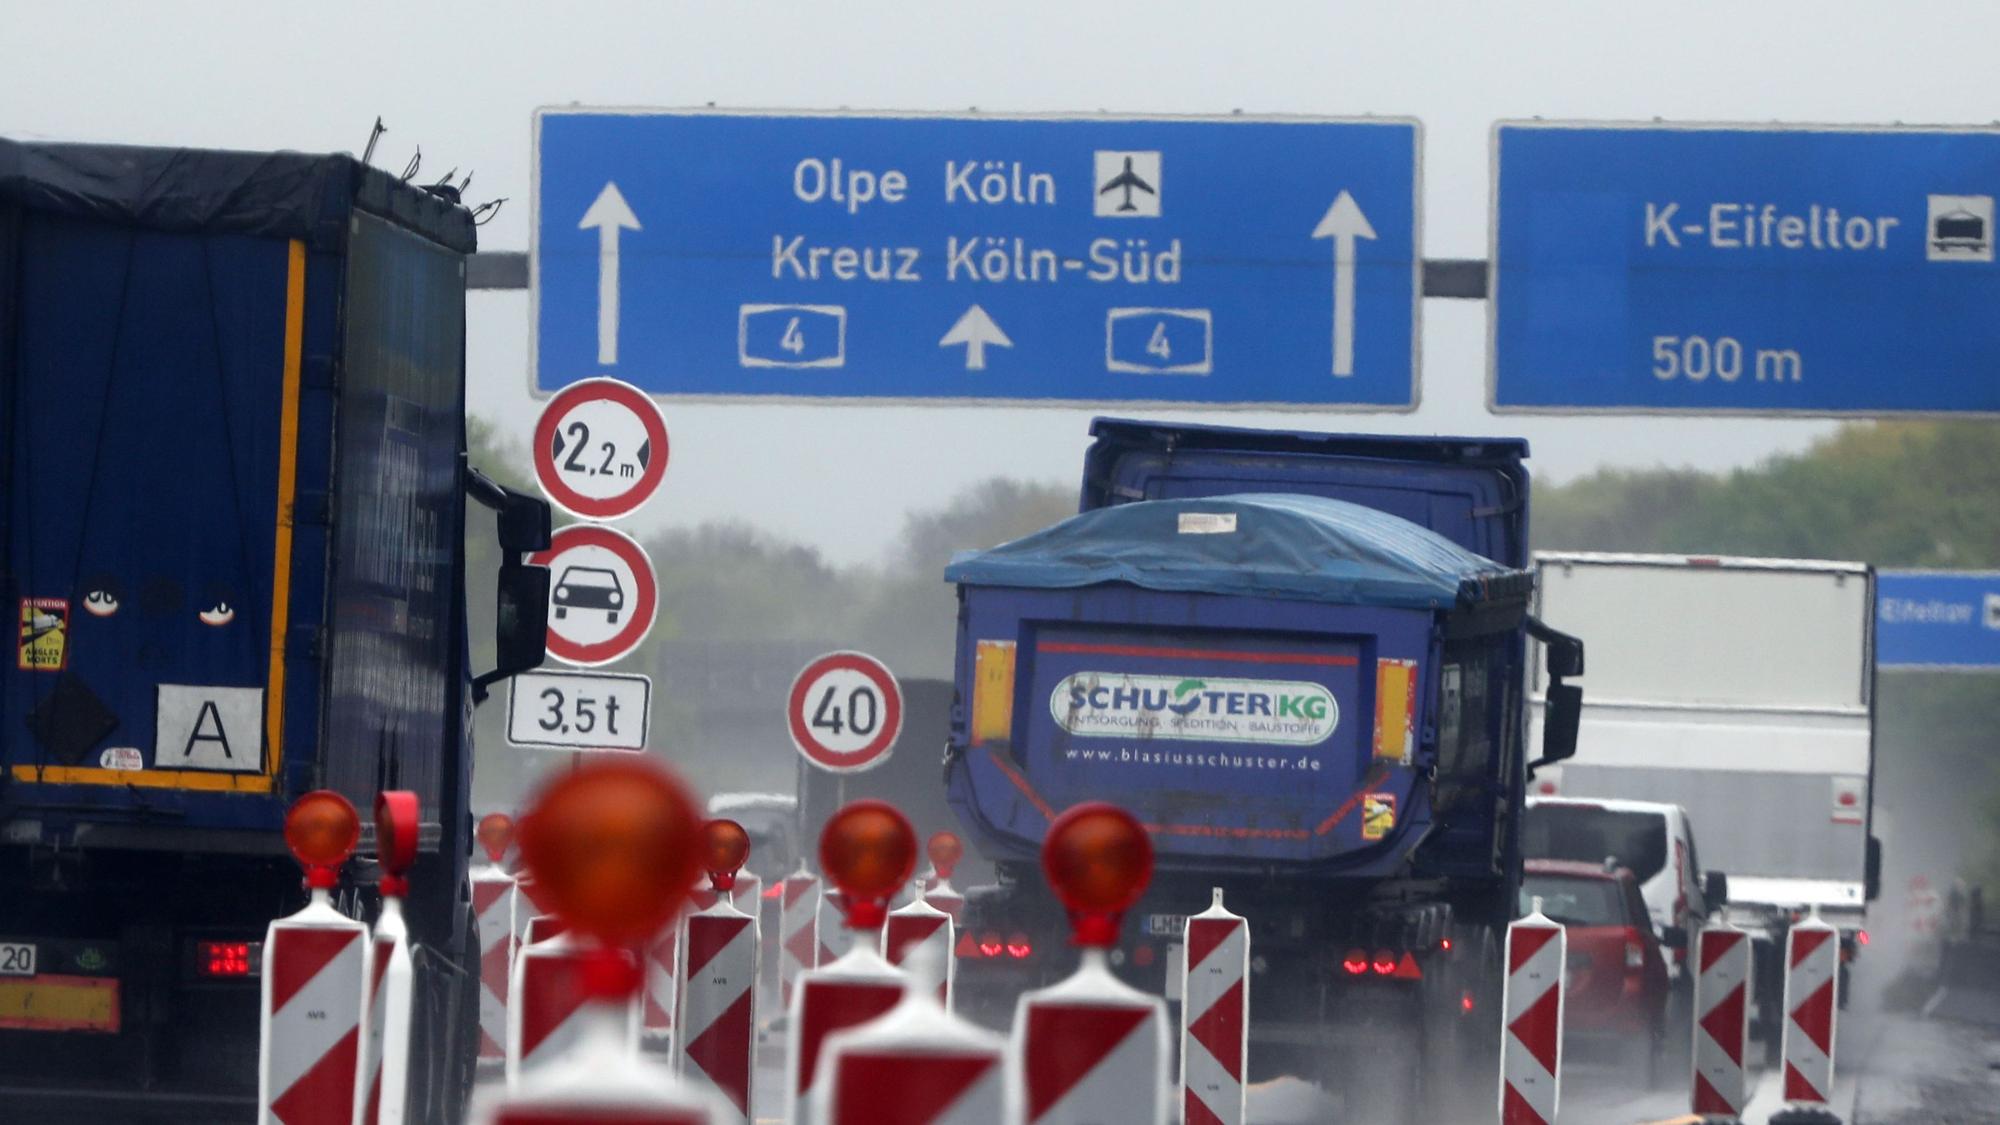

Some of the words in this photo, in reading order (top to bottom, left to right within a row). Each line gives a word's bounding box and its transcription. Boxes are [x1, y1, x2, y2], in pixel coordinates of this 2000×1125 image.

[793, 158, 908, 214] Olpe
[945, 160, 1056, 204] Köln
[1644, 202, 1900, 250] K-Eifeltor
[772, 234, 921, 281] Kreuz
[947, 236, 1182, 284] Köln-Süd
[781, 317, 804, 355] 4
[1147, 321, 1171, 359] 4
[1652, 335, 1743, 382] 500
[1755, 349, 1802, 382] m
[564, 421, 616, 477] 2,2
[620, 463, 635, 478] m
[538, 687, 596, 735] 3,5
[605, 695, 620, 735] t
[812, 685, 877, 736] 40
[1068, 680, 1272, 716] SCHUSTER
[1279, 694, 1327, 719] KG
[183, 700, 233, 759] A
[1065, 747, 1321, 771] www.blasiusschuster.de
